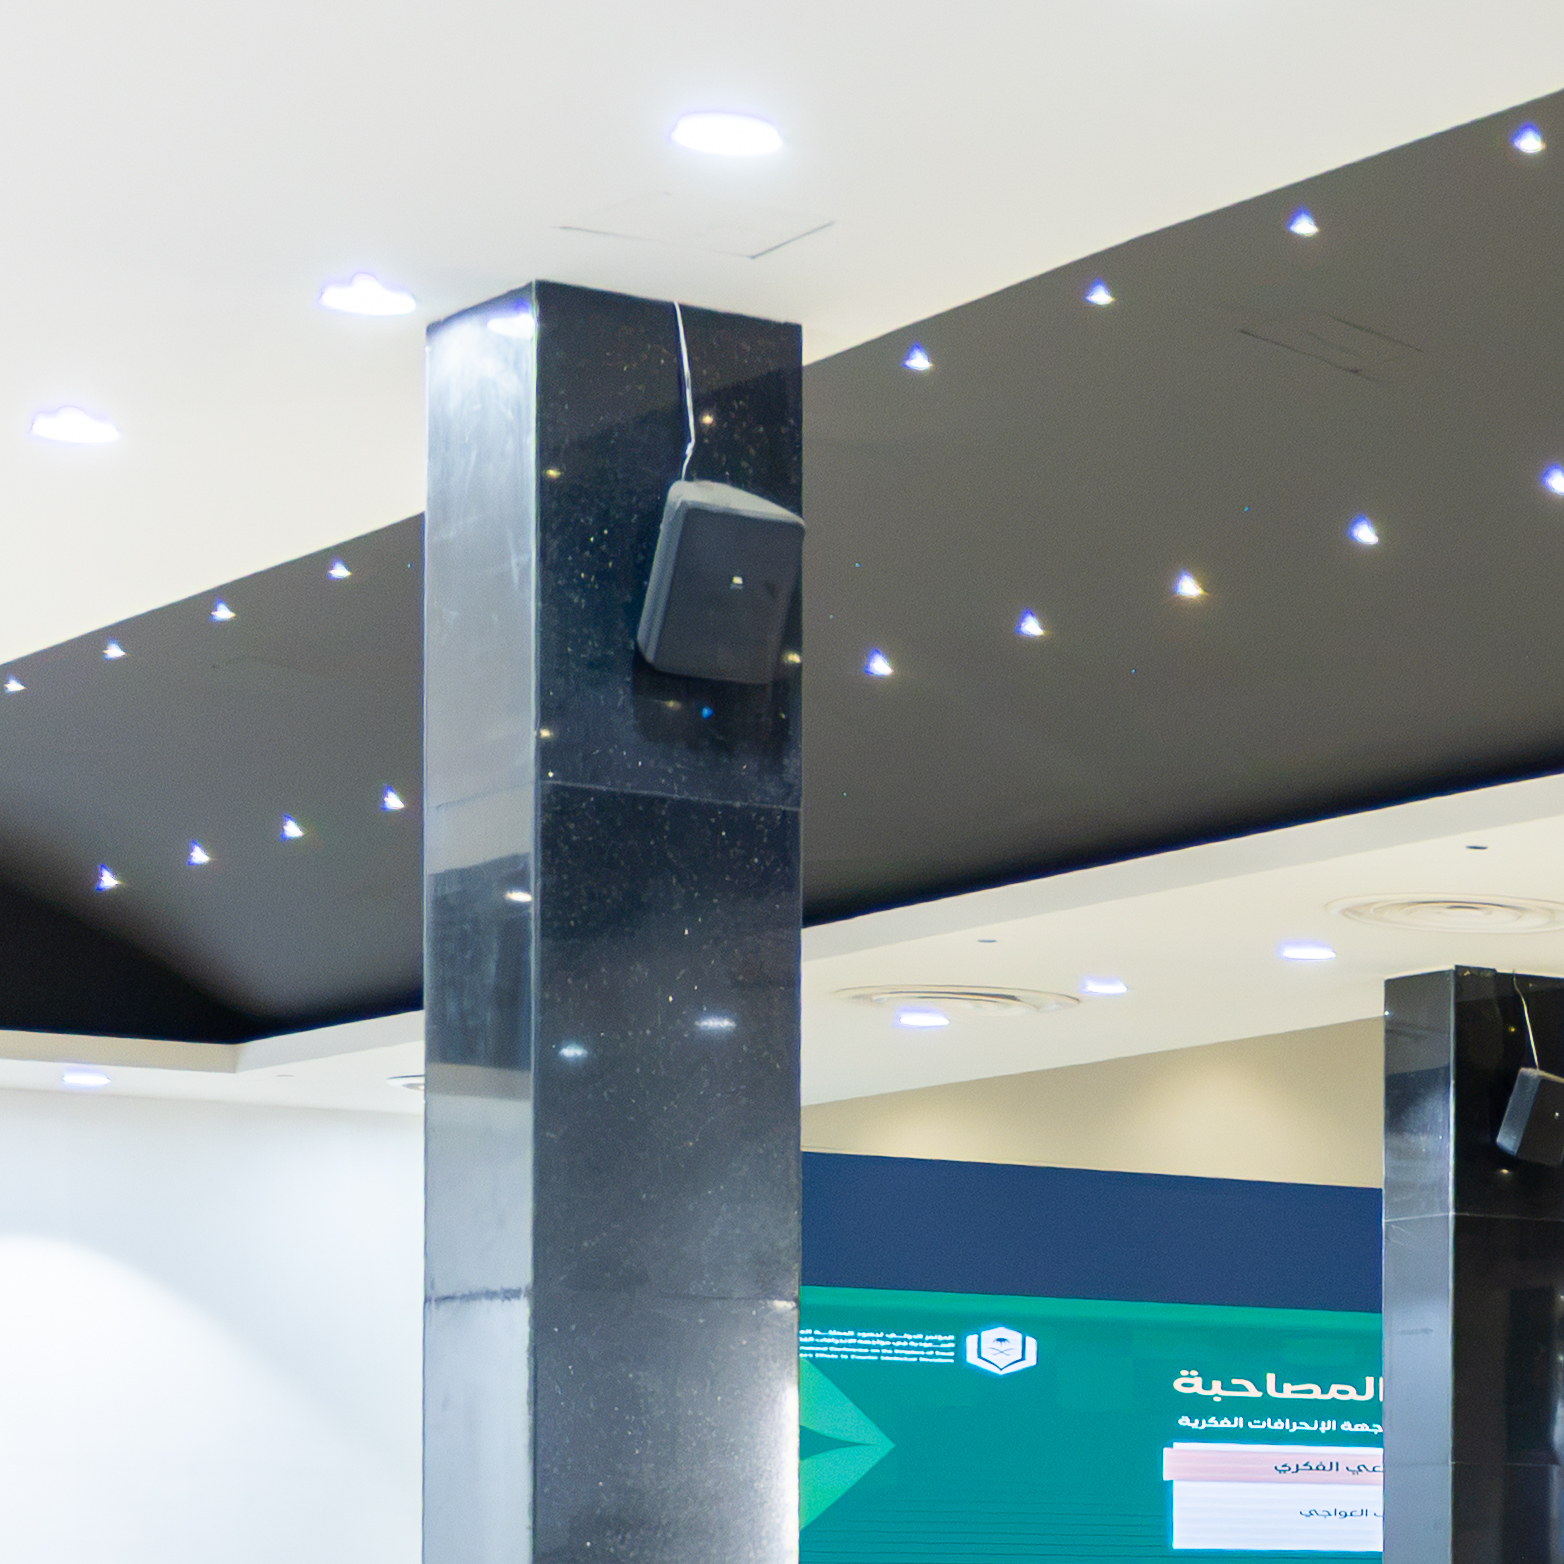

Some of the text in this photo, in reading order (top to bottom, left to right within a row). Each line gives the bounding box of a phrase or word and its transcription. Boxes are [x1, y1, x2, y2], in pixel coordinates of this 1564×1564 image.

[1173, 1370, 1383, 1401] المصاحبة
[1178, 1416, 1383, 1434] جهة الإنحرافات الفكرية
[1274, 1461, 1339, 1474] الفكري
[1300, 1508, 1368, 1519] العواجي
